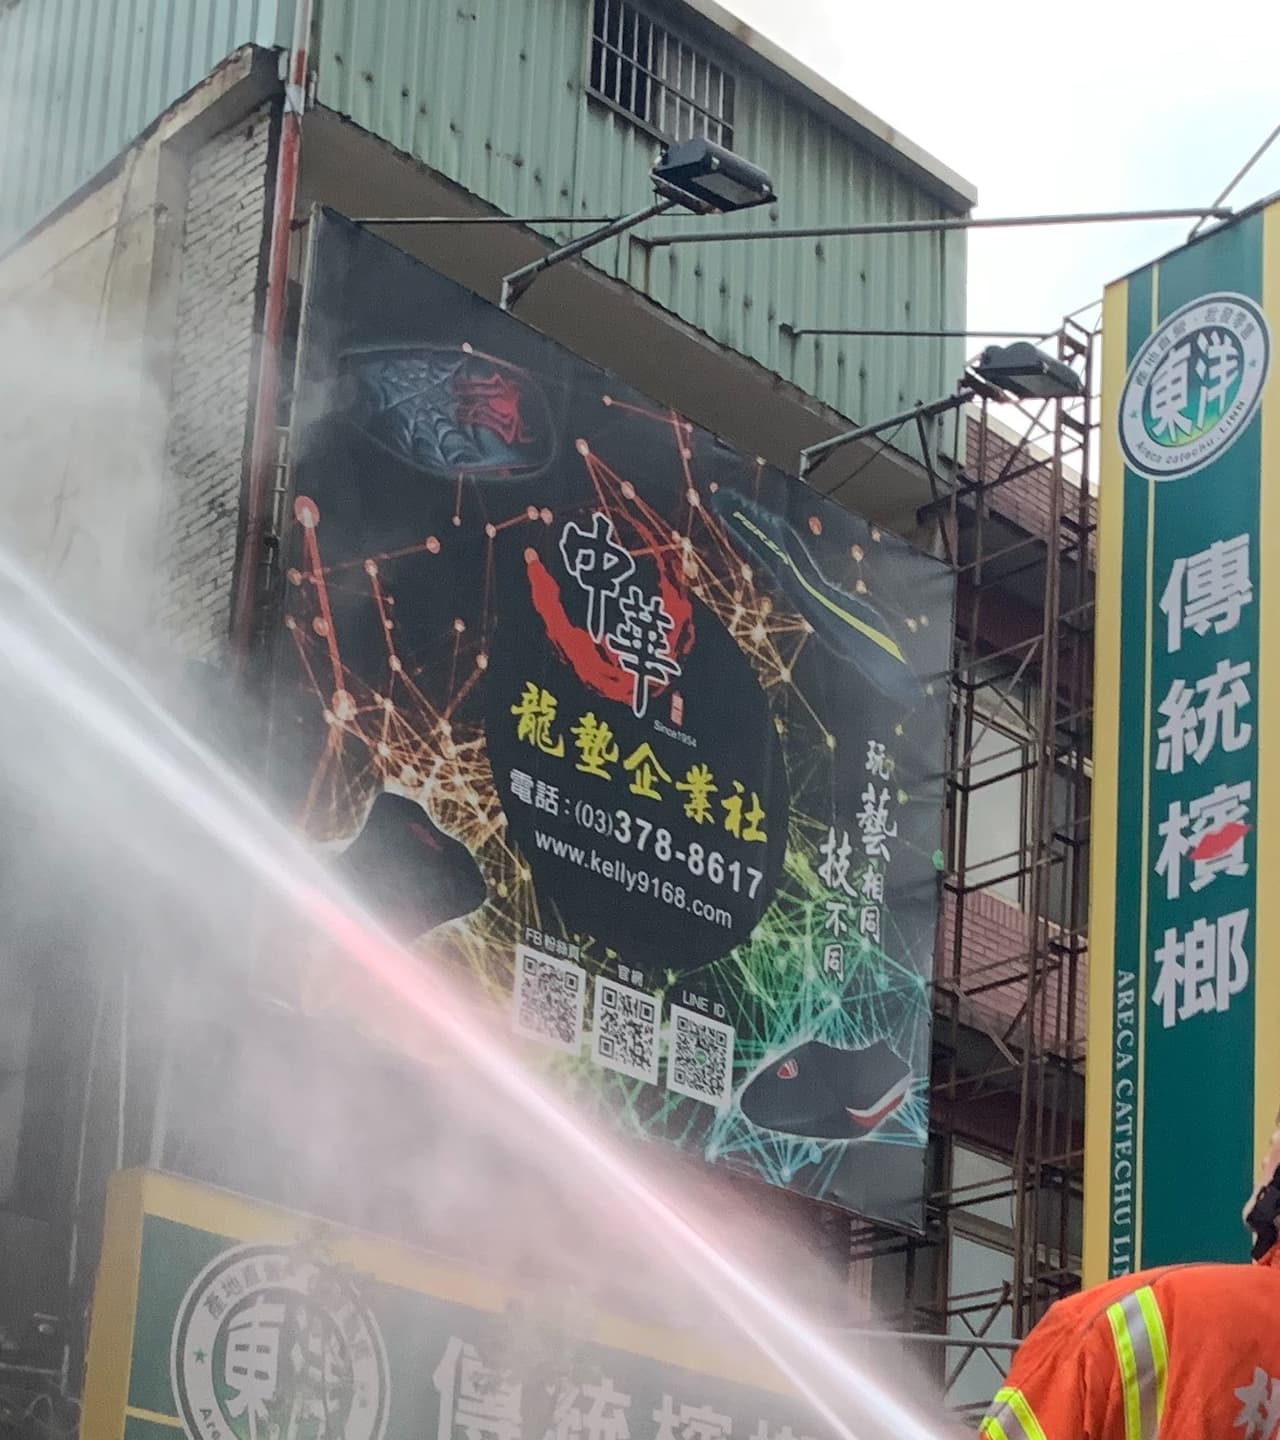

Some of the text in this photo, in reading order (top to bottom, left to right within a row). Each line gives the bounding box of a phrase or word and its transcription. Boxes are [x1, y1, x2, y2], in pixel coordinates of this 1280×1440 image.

[1150, 330, 1240, 443] 東洋
[558, 511, 682, 719] 中華
[510, 681, 768, 843] 龍墊企業社
[1152, 533, 1254, 1029] 傳統檳榔
[534, 830, 733, 929] www.kelly9168.com
[818, 826, 858, 982] 技不同
[856, 740, 898, 944] 玩藝相同
[682, 990, 726, 1018] LINE ID
[1115, 968, 1136, 1072] ARECA
[1113, 1078, 1135, 1227] CATECHU
